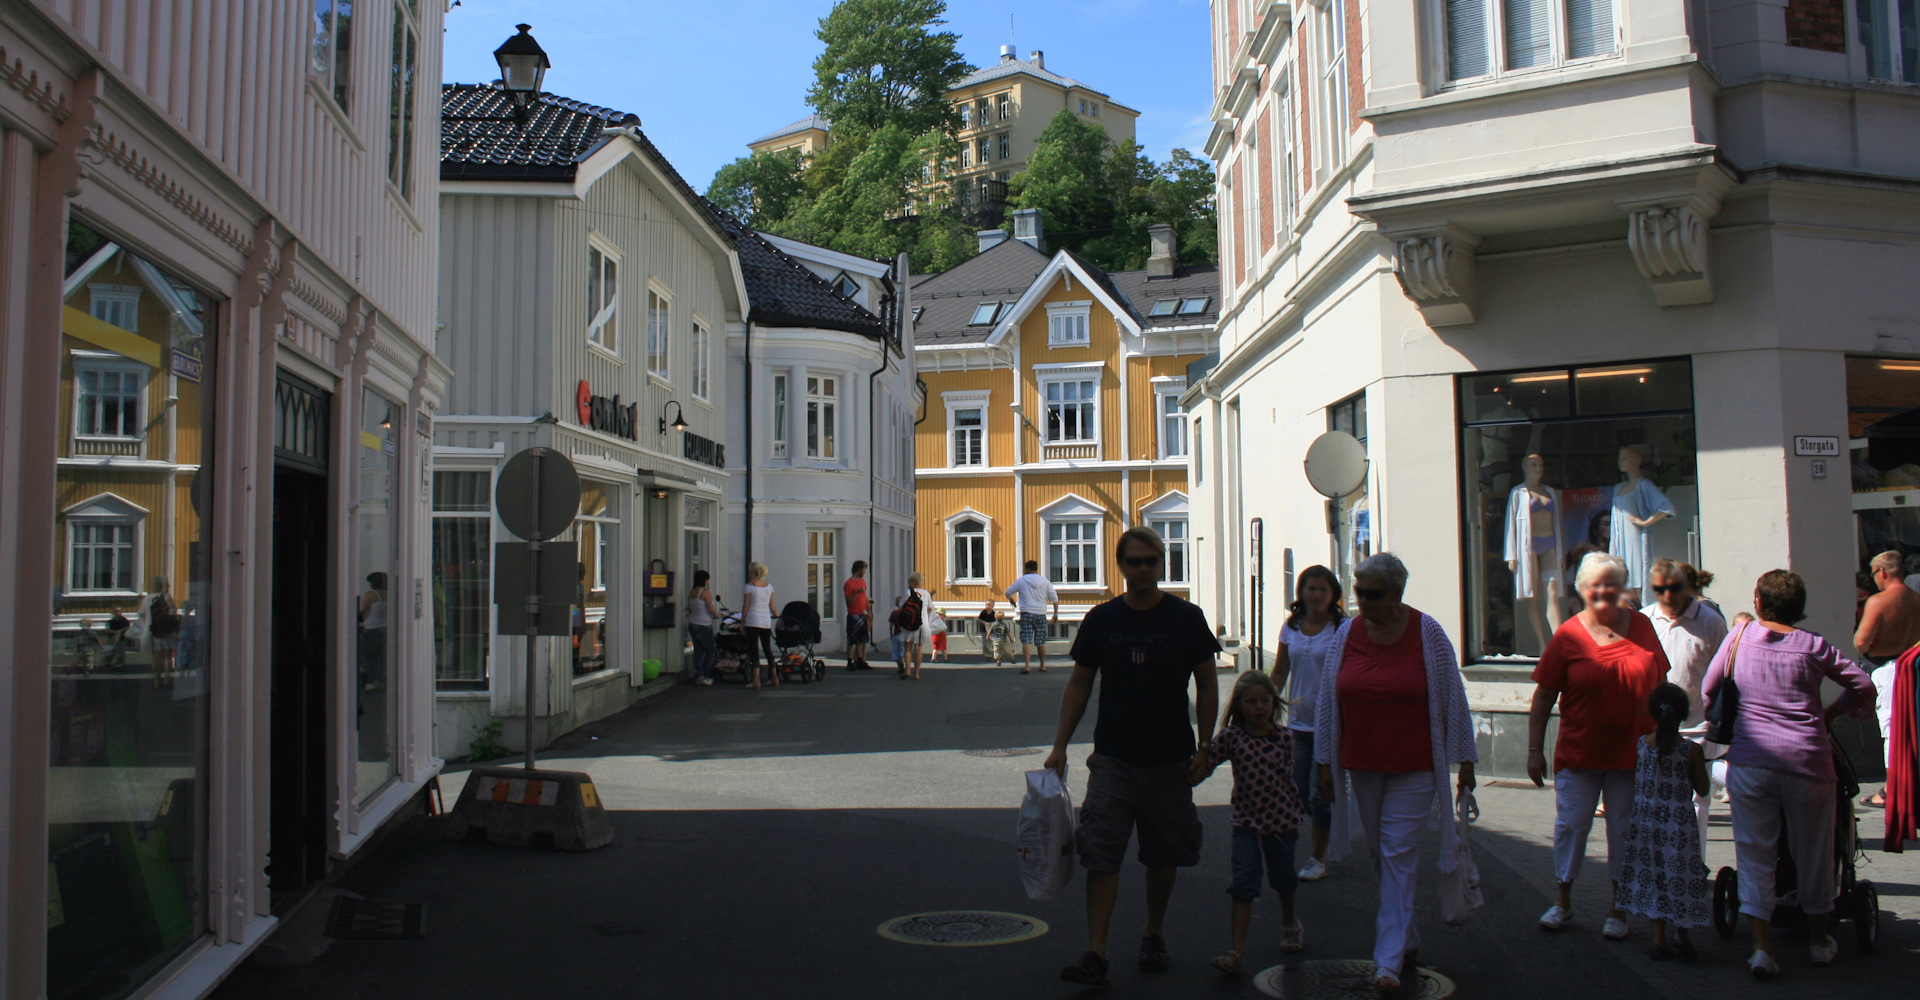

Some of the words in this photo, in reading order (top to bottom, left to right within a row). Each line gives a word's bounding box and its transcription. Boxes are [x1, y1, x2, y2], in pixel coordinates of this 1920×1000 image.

[173, 354, 200, 377] EURONICS
[577, 379, 638, 441] Comfort
[1800, 438, 1834, 453] Storgata
[1814, 464, 1824, 474] 20
[1109, 633, 1168, 644] GANT
